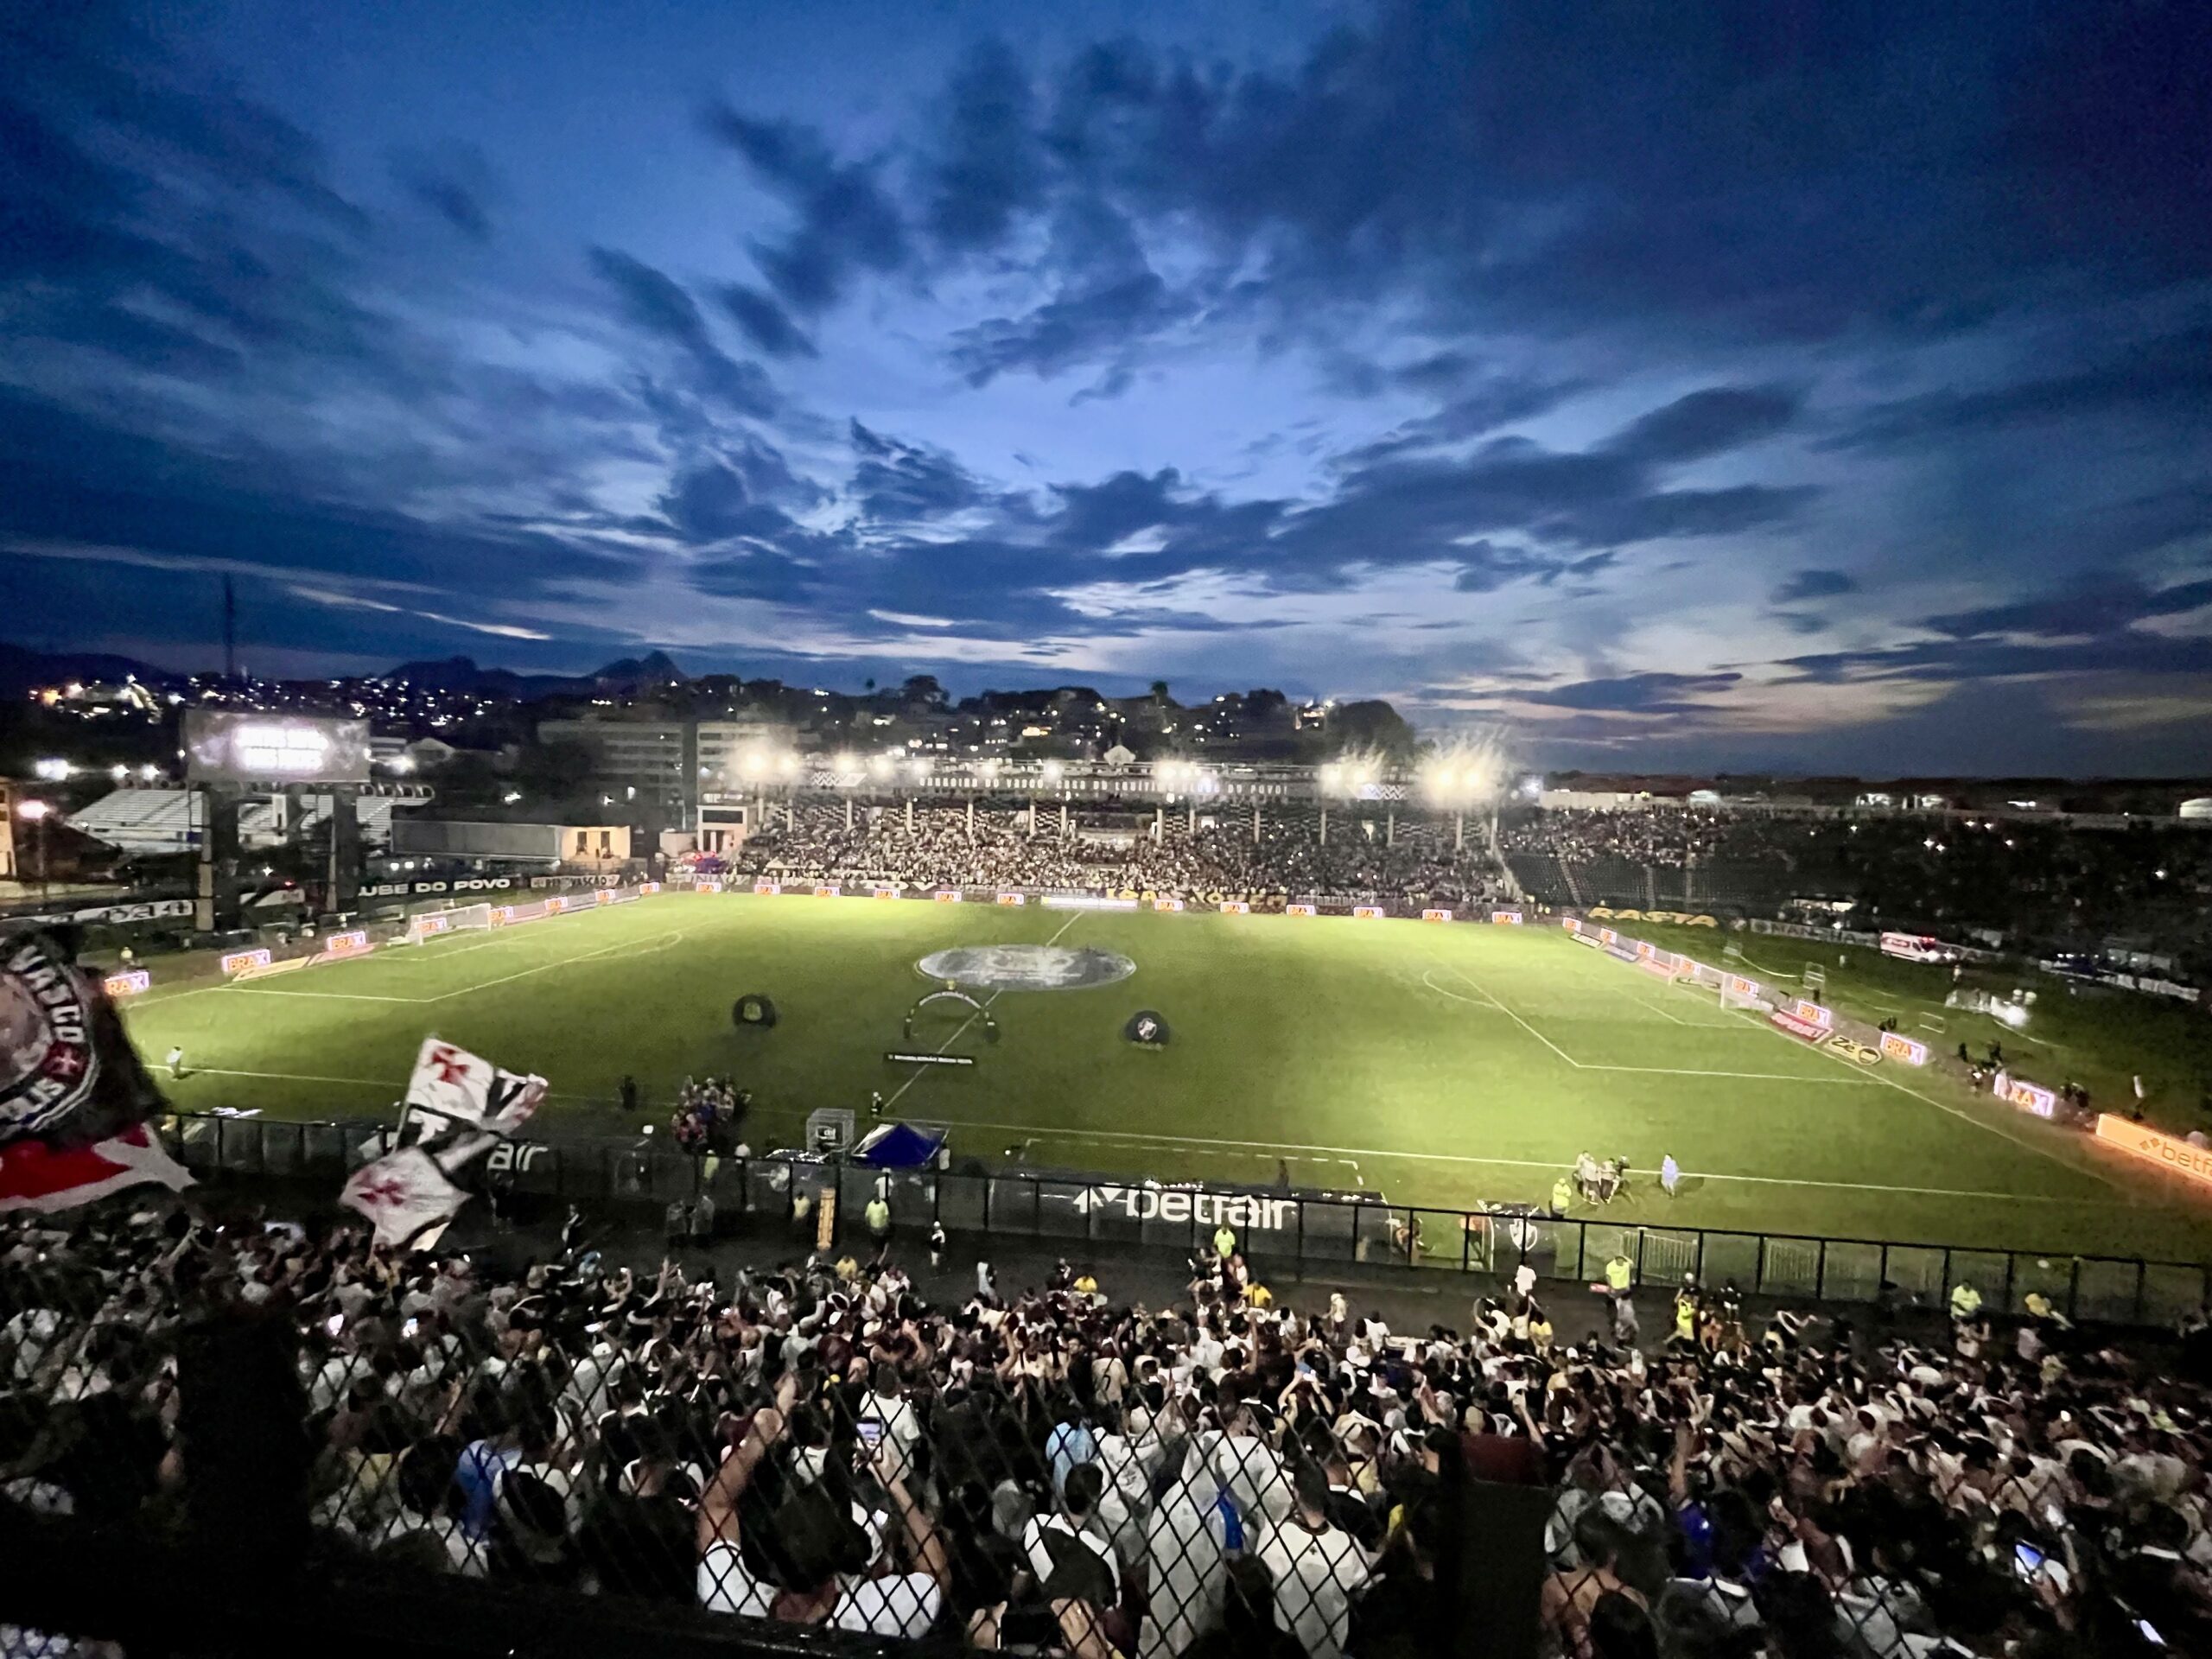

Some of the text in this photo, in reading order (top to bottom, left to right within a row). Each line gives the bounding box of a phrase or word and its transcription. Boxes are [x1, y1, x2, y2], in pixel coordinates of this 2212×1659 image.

[416, 880, 447, 893] DO
[454, 878, 510, 891] POVO
[227, 953, 268, 971] BRAX
[106, 976, 147, 995] RAX
[1800, 1003, 1828, 1027] BRAX
[1885, 1035, 1922, 1064] BRAX
[1125, 1189, 1297, 1230] betfair
